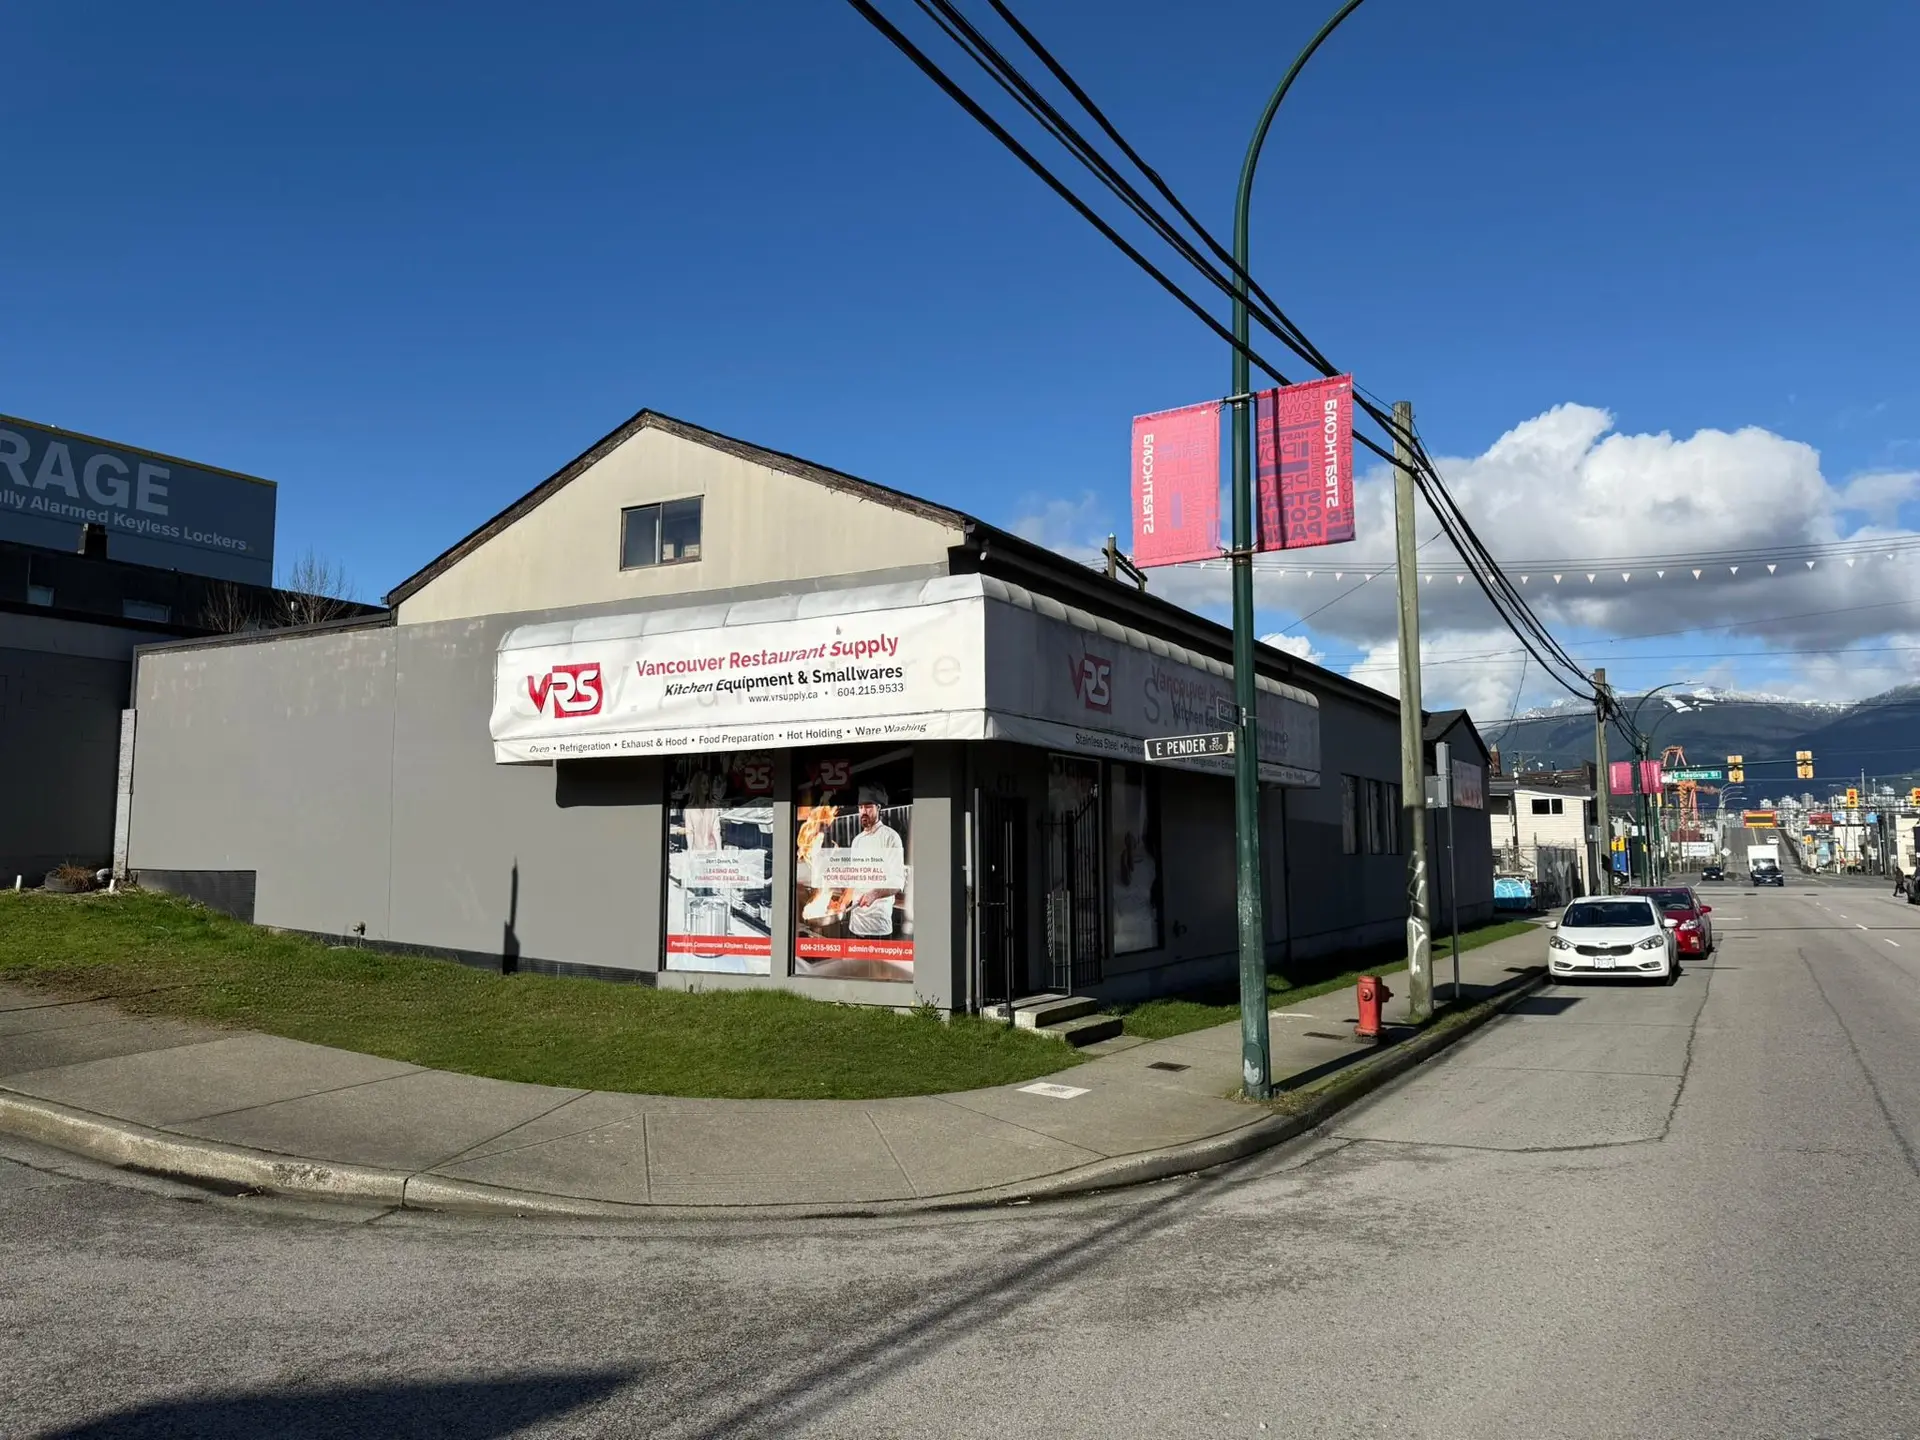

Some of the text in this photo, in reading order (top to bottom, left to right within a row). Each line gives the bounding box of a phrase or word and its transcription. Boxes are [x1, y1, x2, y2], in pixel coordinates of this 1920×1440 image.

[31, 495, 109, 524] Alarmed
[114, 512, 180, 539] Keyless
[184, 526, 247, 552] Lockers
[637, 634, 899, 677] Vancouver Restaurant Supply
[528, 662, 604, 719] VRS
[665, 665, 903, 697] Kitchen Equipment & Smallwares
[748, 682, 904, 704] www.vrsupply.ca 604.215.9533
[529, 722, 927, 753] Oven Refrigeration Exhaust & Hood Food Preparation Hot Holding Ware Washing
[1156, 742, 1162, 756] E
[1167, 739, 1206, 758] PENDER
